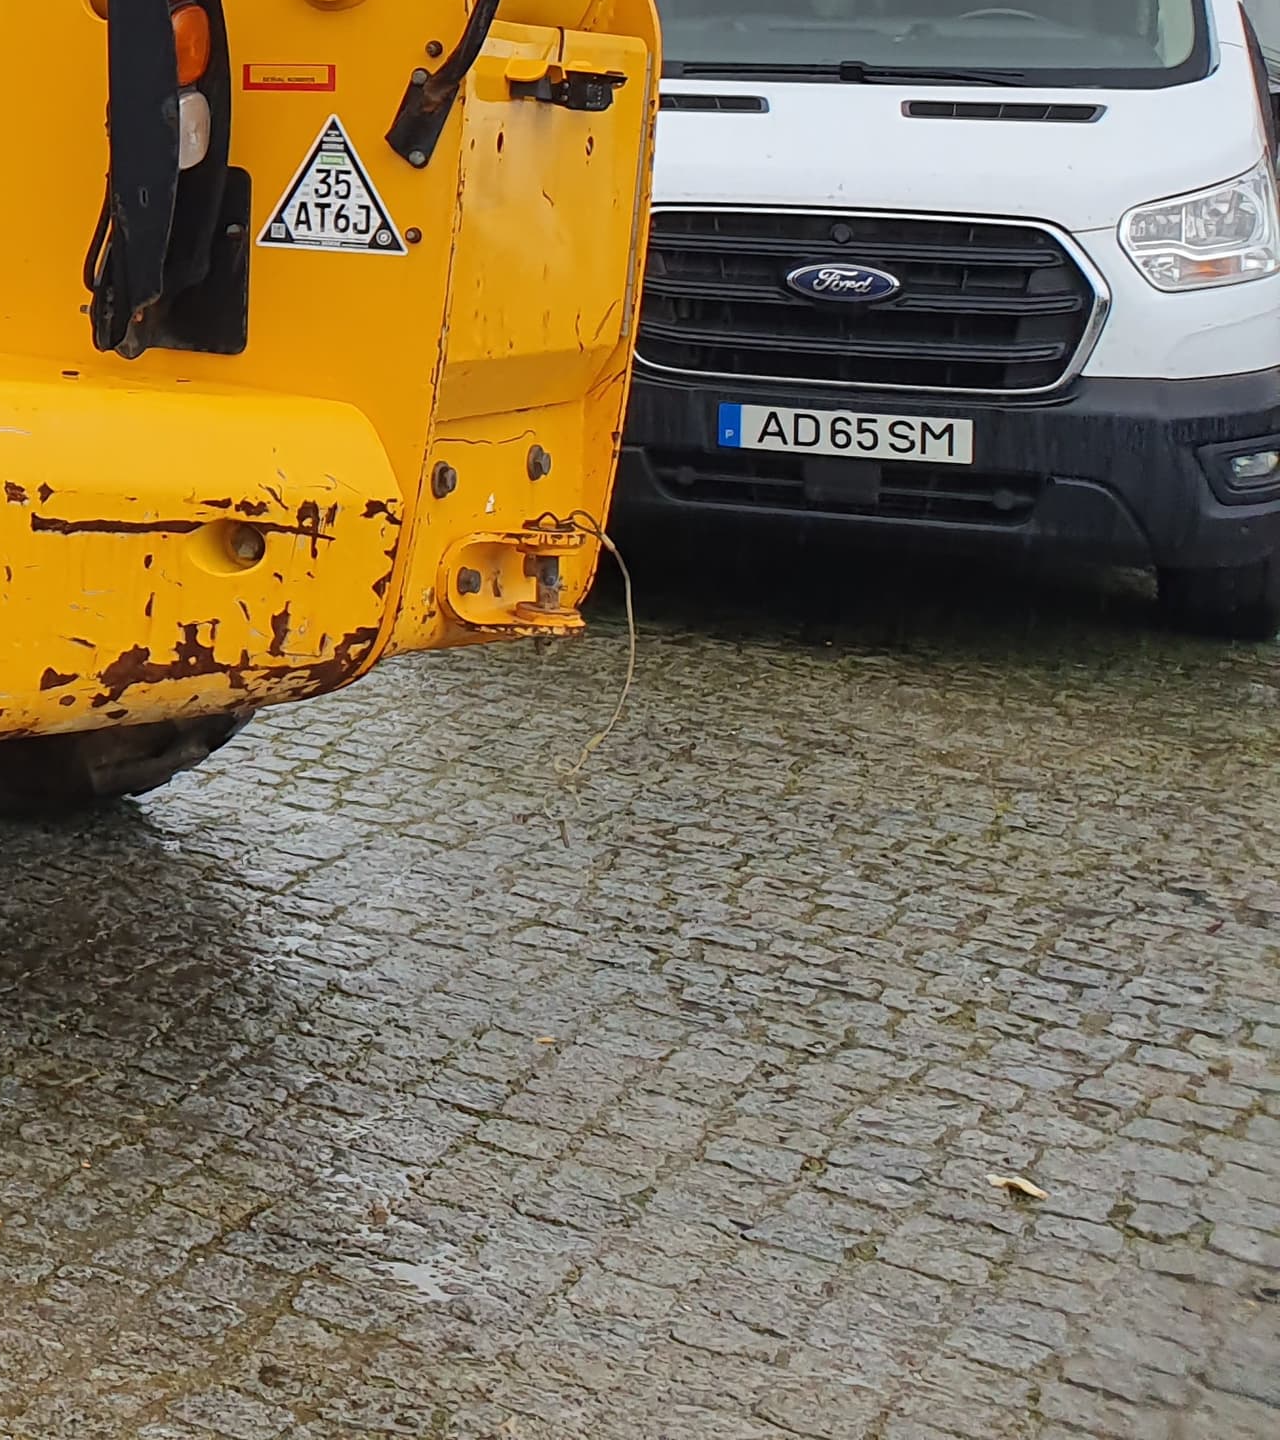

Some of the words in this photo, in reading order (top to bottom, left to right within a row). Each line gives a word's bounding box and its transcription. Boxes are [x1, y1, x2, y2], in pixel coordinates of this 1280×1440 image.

[313, 168, 352, 200] 35
[293, 201, 371, 235] AT6J
[812, 268, 873, 294] Ford
[757, 411, 821, 448] AD
[830, 416, 879, 452] 65
[887, 420, 954, 457] SM
